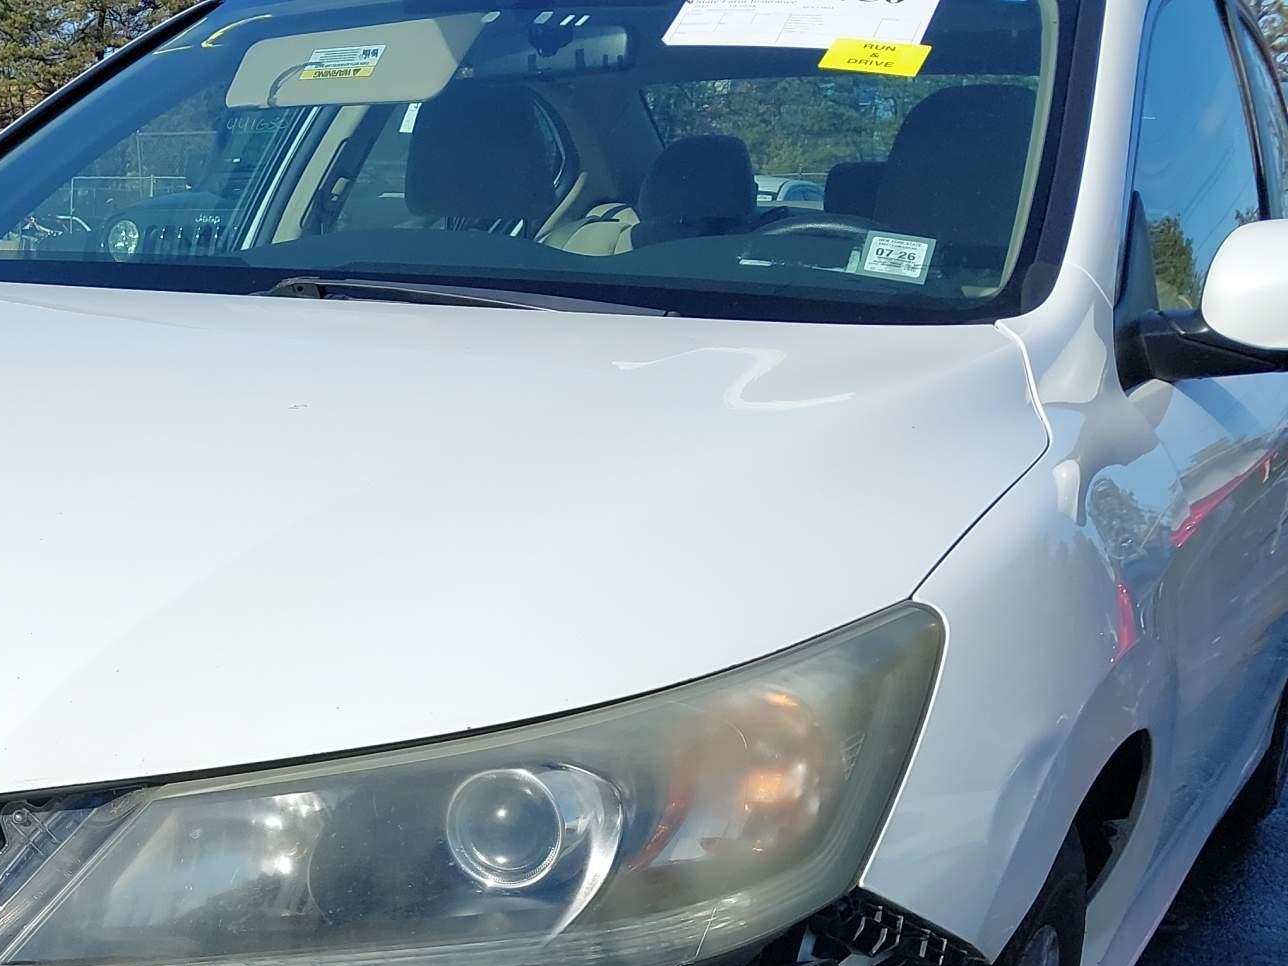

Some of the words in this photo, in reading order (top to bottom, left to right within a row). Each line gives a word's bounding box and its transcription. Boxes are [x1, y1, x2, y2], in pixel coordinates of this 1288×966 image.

[863, 43, 896, 52] RUN
[847, 58, 895, 68] DRIVE
[875, 247, 894, 257] 07
[898, 251, 916, 261] 26
